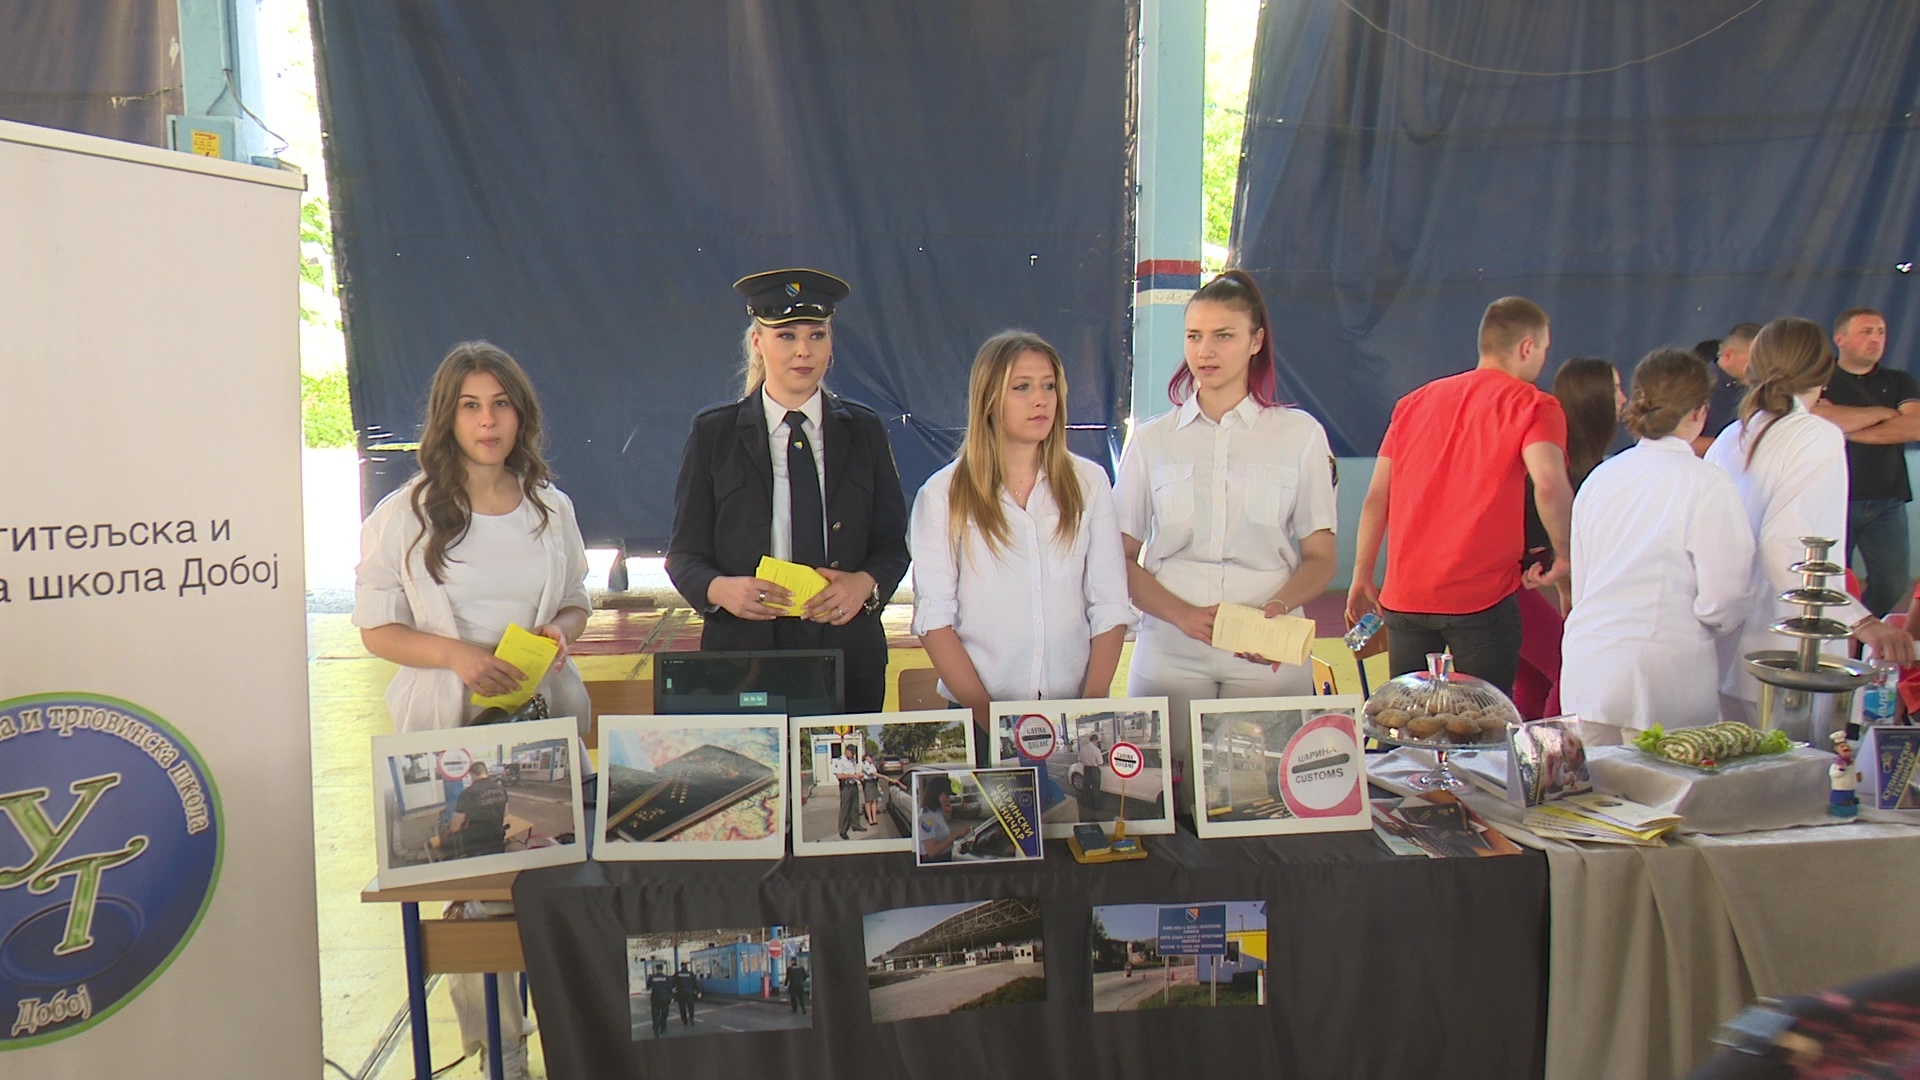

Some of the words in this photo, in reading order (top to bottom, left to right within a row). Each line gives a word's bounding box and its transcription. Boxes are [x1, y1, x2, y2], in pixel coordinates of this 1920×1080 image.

[210, 518, 231, 542] и
[29, 565, 166, 601] школа
[179, 553, 279, 597] Добој
[20, 708, 43, 734] и
[47, 706, 179, 769] трговинска
[167, 760, 210, 835] школа
[1295, 768, 1344, 784] CUSTOMS
[996, 783, 1035, 838] ЦАРИНСКИ
[11, 984, 92, 1037] Добој
